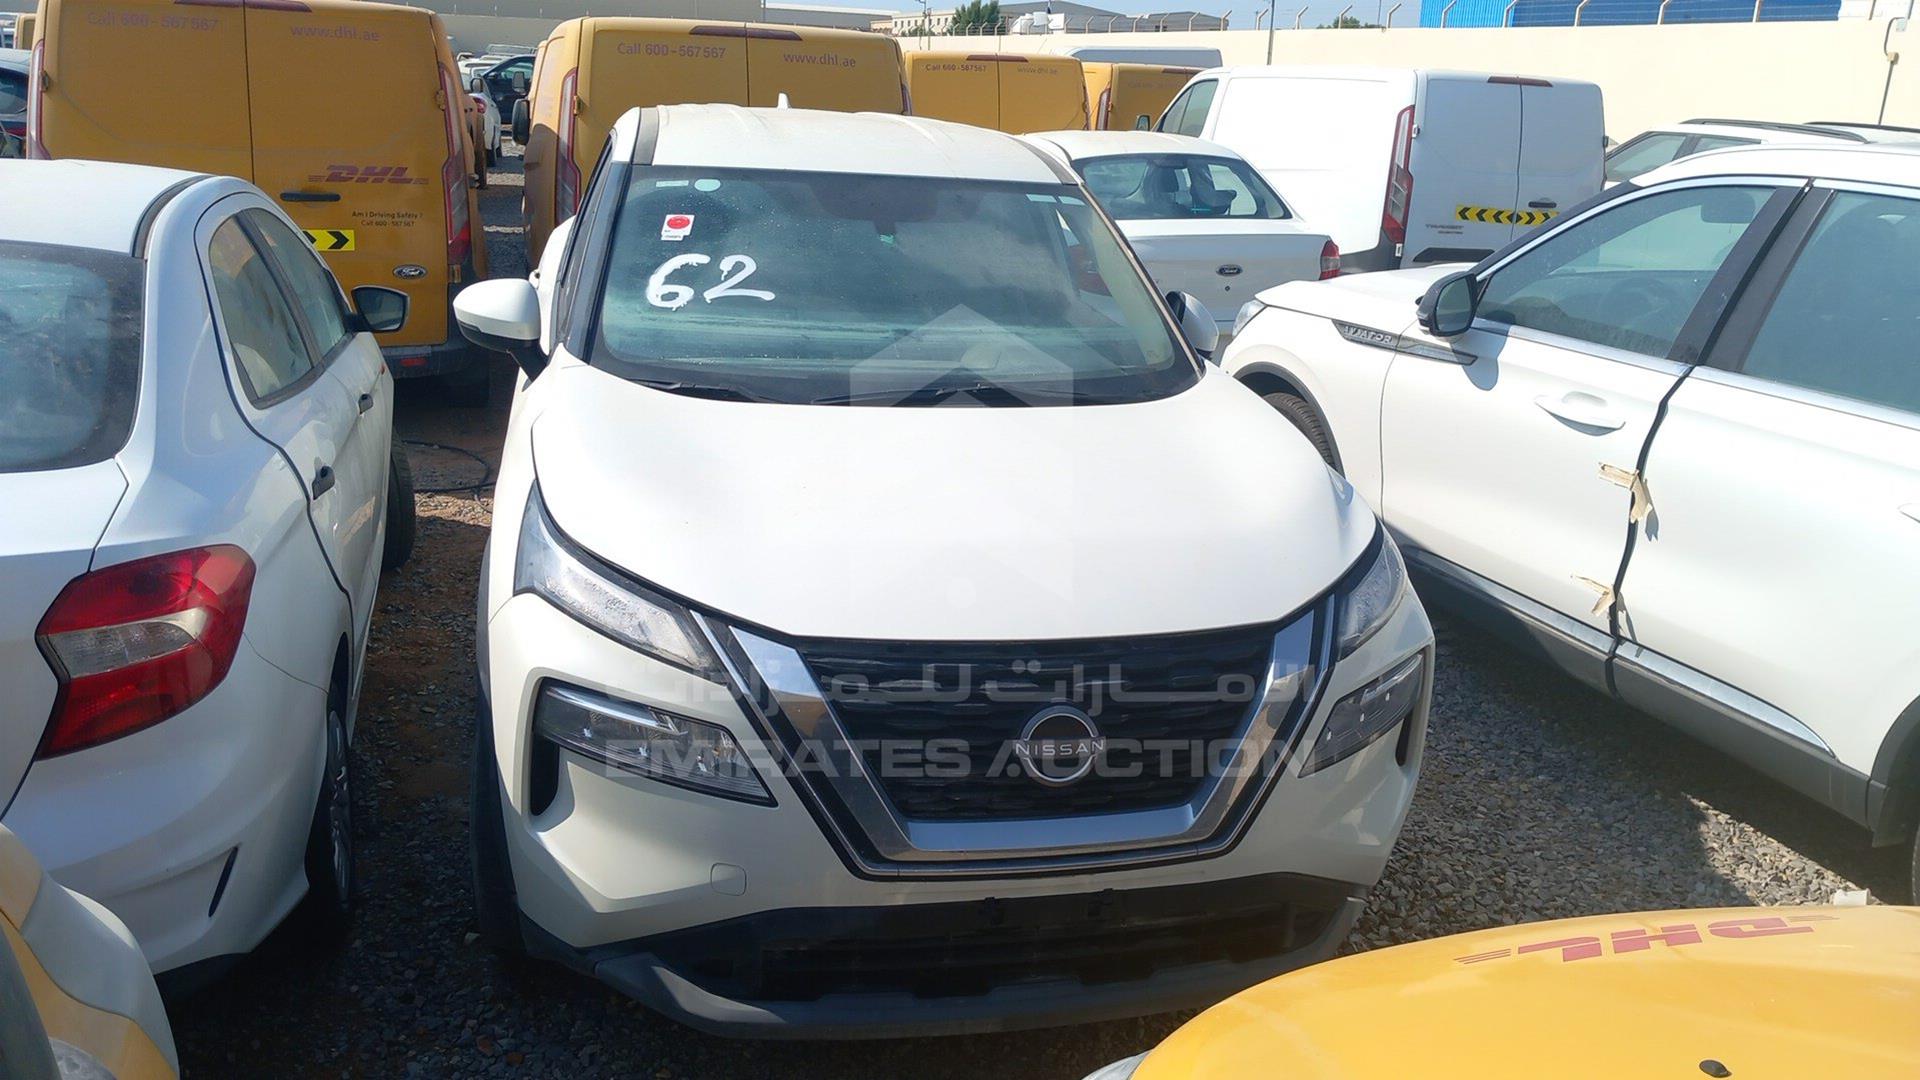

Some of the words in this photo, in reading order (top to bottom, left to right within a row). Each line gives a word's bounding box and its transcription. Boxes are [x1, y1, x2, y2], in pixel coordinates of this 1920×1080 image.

[617, 42, 641, 56] Call
[645, 43, 669, 56] 600
[783, 52, 856, 68] www.dhl.ae
[325, 165, 413, 184] DHL
[646, 253, 776, 311] 62
[1015, 739, 1105, 756] NISSAN
[1518, 916, 1814, 962] DHL
